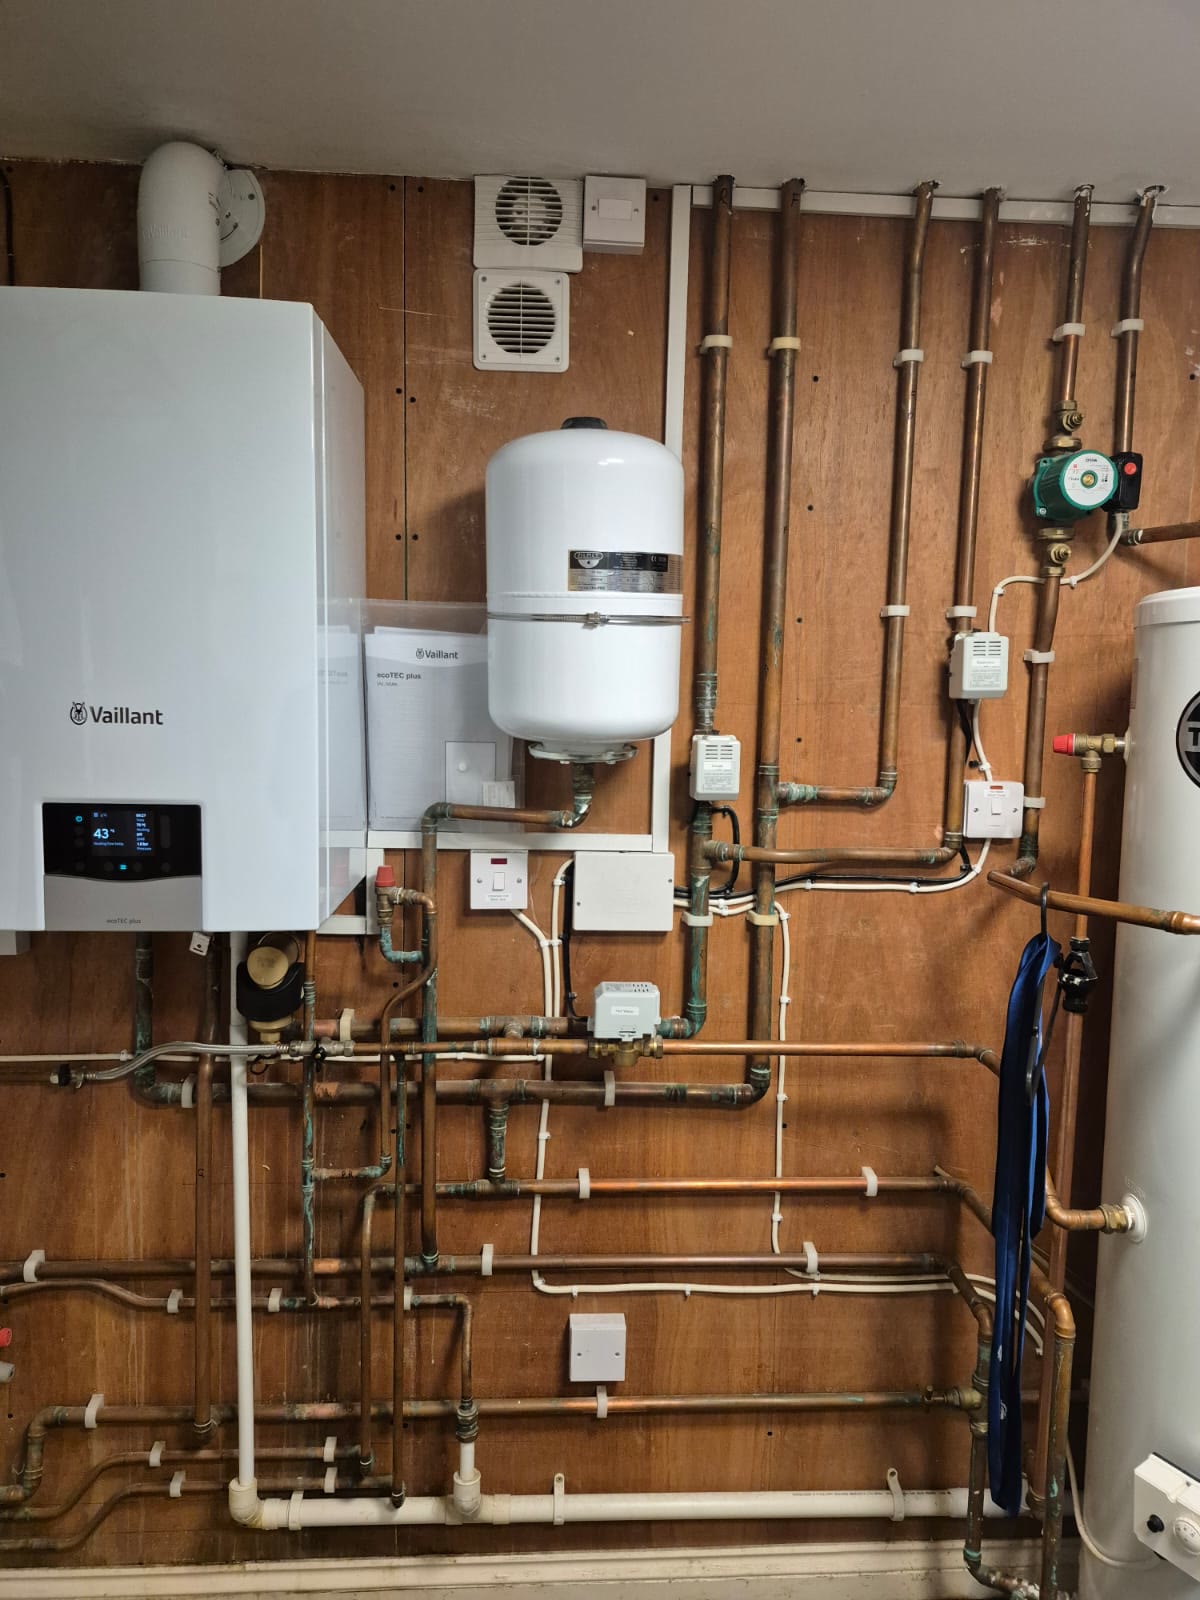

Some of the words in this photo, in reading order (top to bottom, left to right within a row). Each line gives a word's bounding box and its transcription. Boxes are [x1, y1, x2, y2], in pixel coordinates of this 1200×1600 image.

[425, 650, 459, 660] Vaillant
[89, 706, 163, 725] Vaillant
[93, 828, 109, 839] 43
